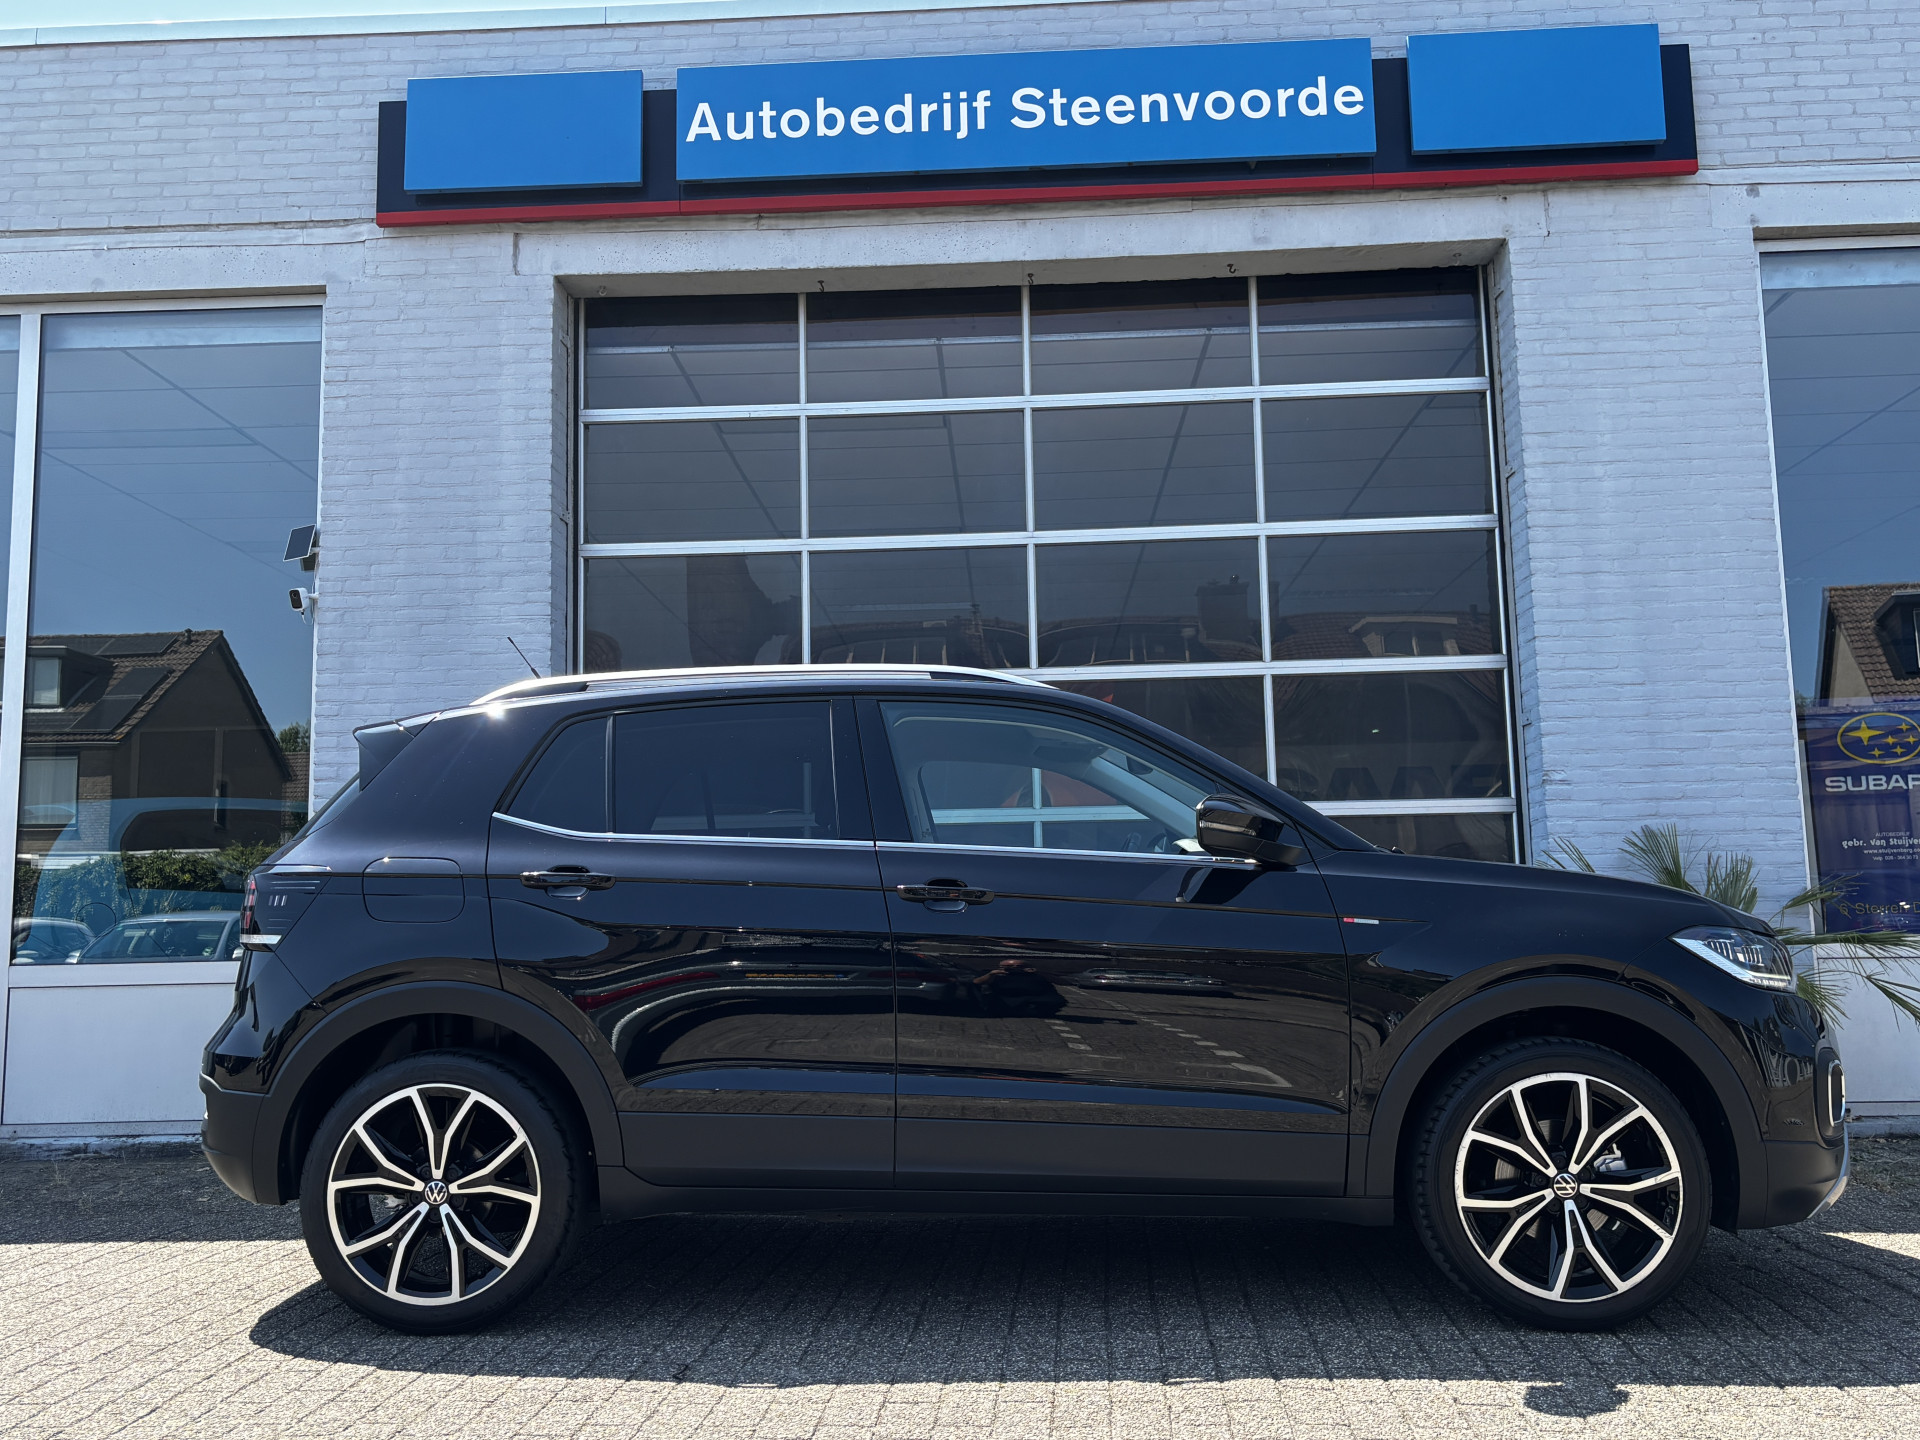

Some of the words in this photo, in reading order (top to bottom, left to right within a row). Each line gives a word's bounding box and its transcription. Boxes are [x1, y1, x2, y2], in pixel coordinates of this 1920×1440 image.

[686, 89, 991, 143] Autobedrijf
[1010, 76, 1365, 130] Steenvoorde
[1842, 838, 1867, 849] gebr.
